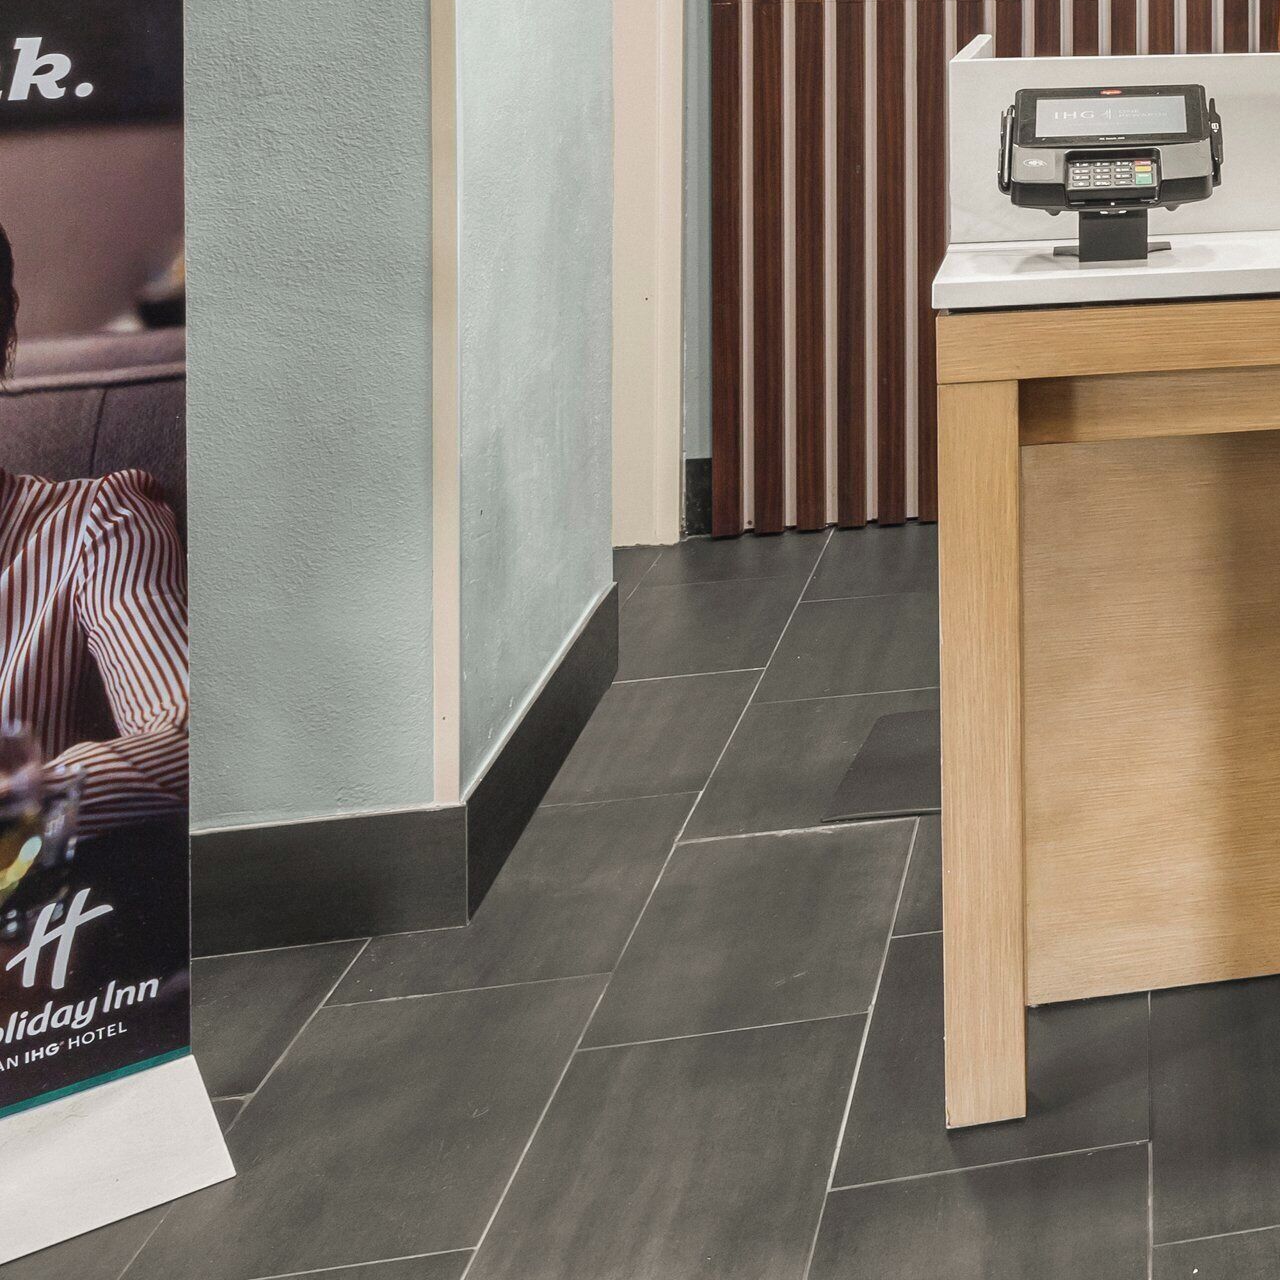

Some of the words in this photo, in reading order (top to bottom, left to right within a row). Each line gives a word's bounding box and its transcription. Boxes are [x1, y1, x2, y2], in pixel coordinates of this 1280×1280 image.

[1055, 110, 1095, 120] IHG
[0, 993, 98, 1046] liday
[103, 979, 160, 1014] Inn
[24, 1042, 60, 1065] IHG
[68, 1021, 128, 1050] HOTEL
